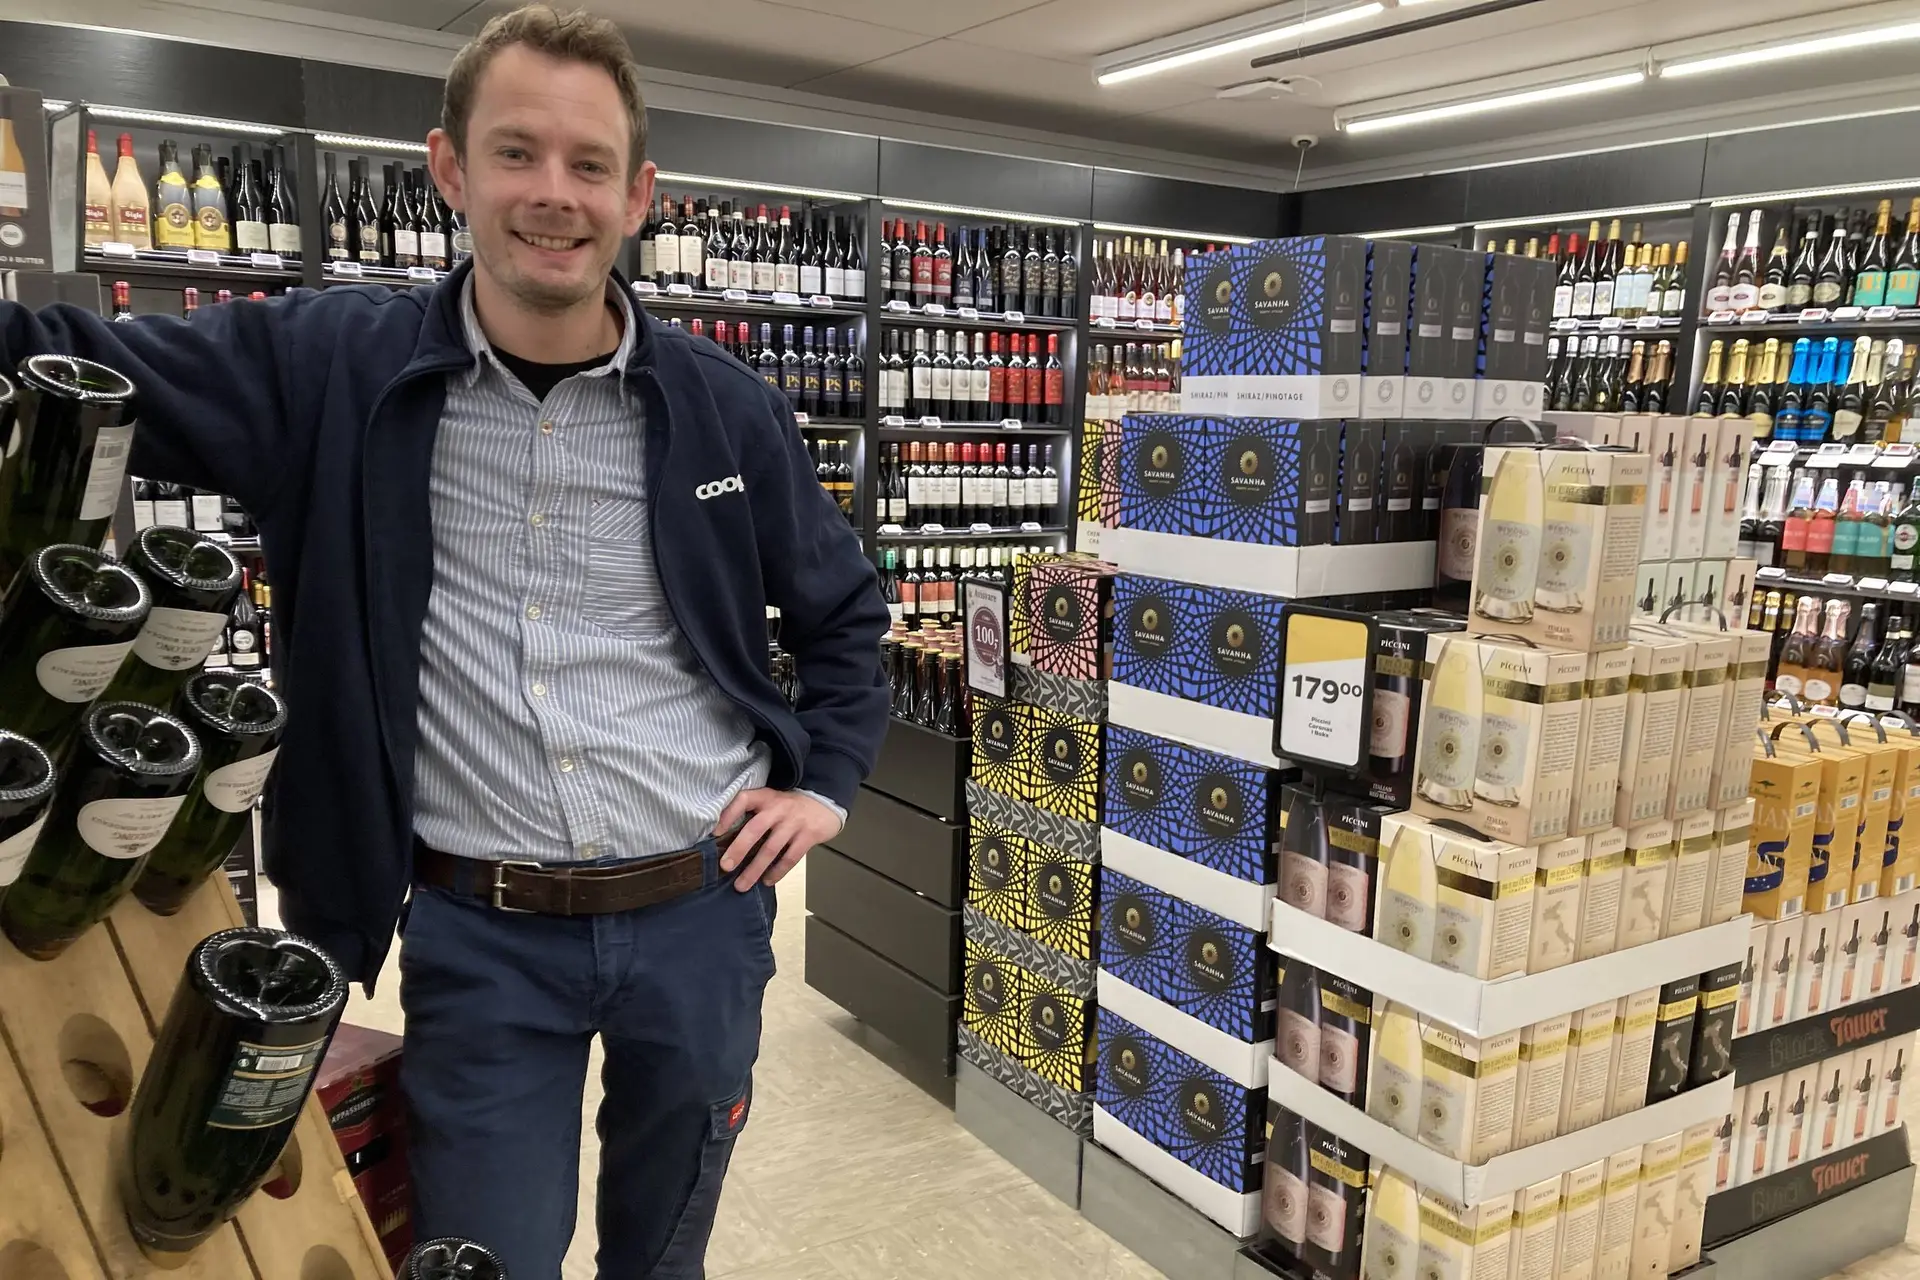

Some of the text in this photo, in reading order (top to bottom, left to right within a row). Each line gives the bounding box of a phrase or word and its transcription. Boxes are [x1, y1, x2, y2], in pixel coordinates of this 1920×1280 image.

[1254, 300, 1290, 309] SAVANHA
[825, 379, 841, 391] PS
[1237, 392, 1303, 401] SHIRAZ/PINOTAGE
[1144, 470, 1175, 479] SAVANHA
[1230, 476, 1266, 486] SAVANHA
[1048, 617, 1074, 628] SAVANHA
[1134, 630, 1165, 642] SAVANHA
[1217, 647, 1252, 660] SAVANHA
[986, 738, 1008, 750] SAVANHA
[1048, 757, 1074, 771] SAVANHA
[1125, 781, 1154, 796] SAVANHA
[1203, 808, 1235, 824] SAVANHA
[1120, 925, 1146, 942] SAVANHA
[1194, 960, 1225, 980] SAVANHA
[1830, 1007, 1888, 1047] Tower
[1115, 1065, 1141, 1085] SAVANHA
[1186, 1109, 1216, 1131] SAVANHA
[1812, 1153, 1870, 1195] Tower
